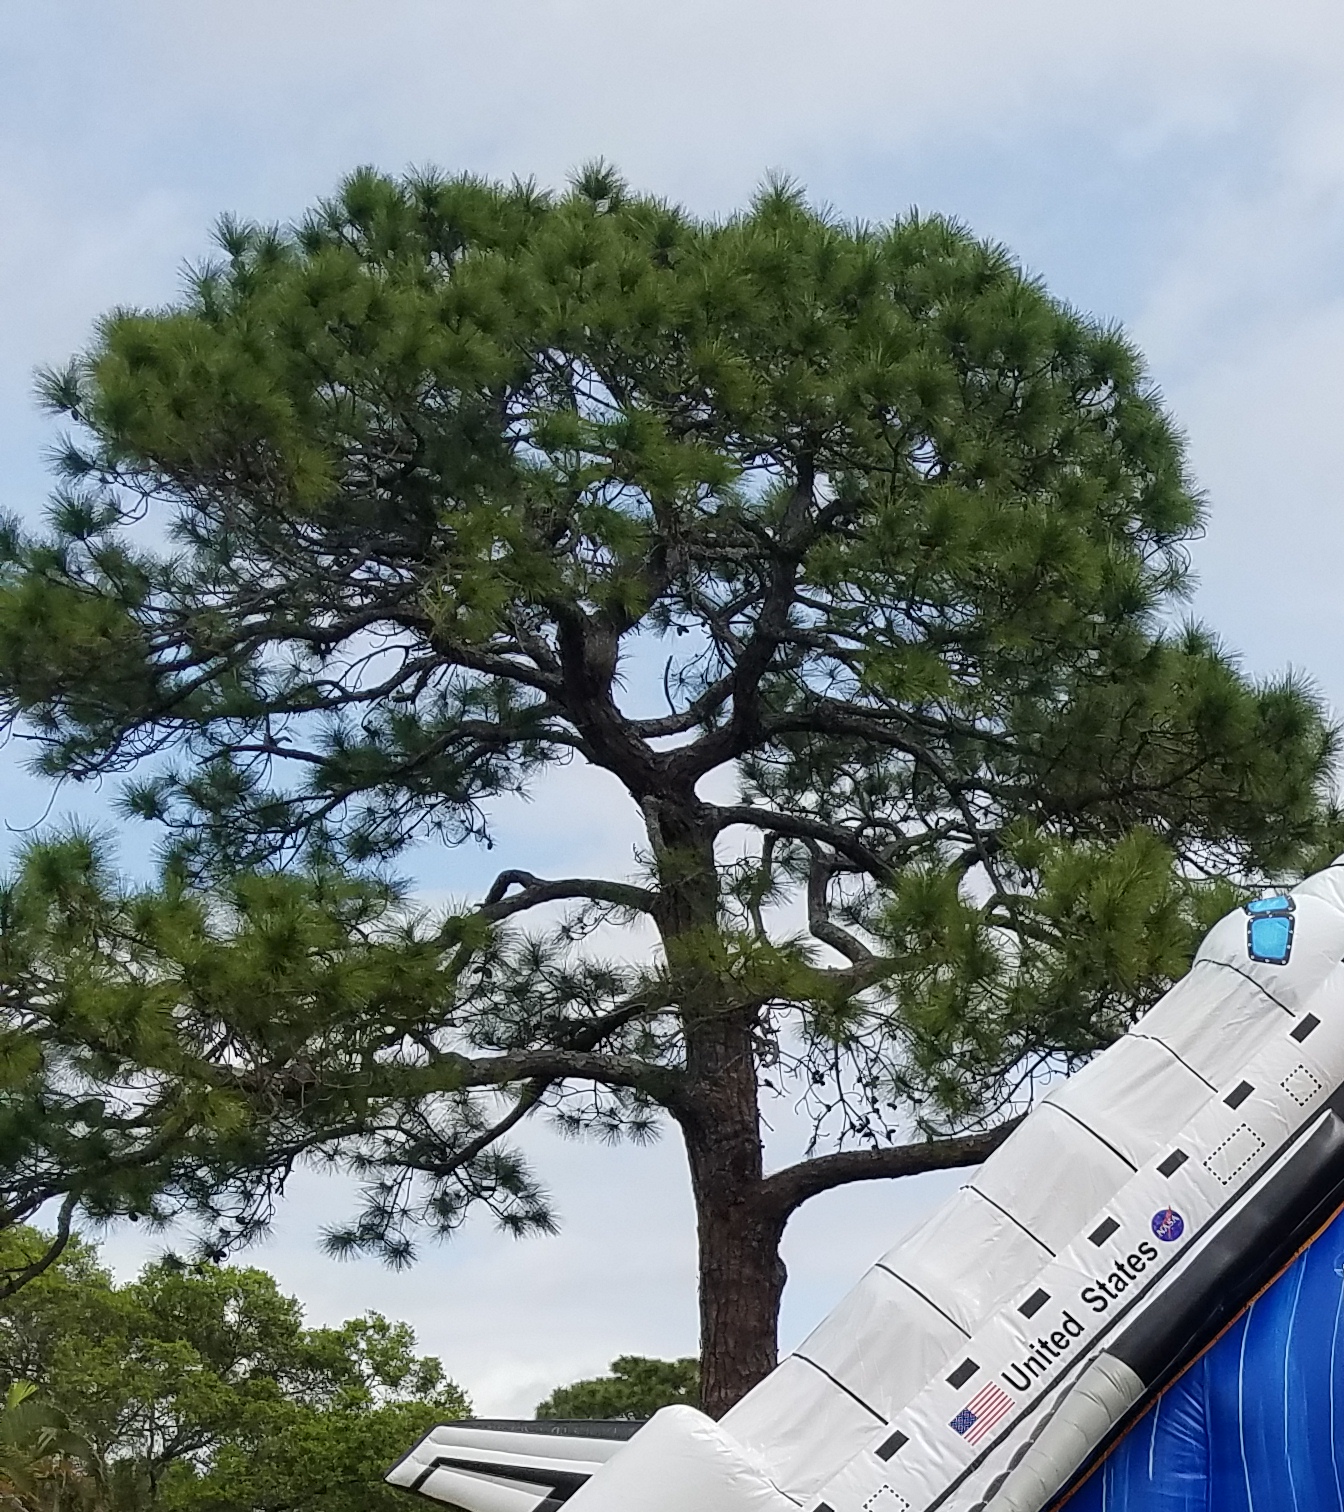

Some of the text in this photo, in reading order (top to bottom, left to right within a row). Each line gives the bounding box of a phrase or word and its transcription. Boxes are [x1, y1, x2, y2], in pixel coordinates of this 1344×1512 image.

[1156, 1214, 1180, 1237] NASA
[1000, 1241, 1158, 1392] United States
